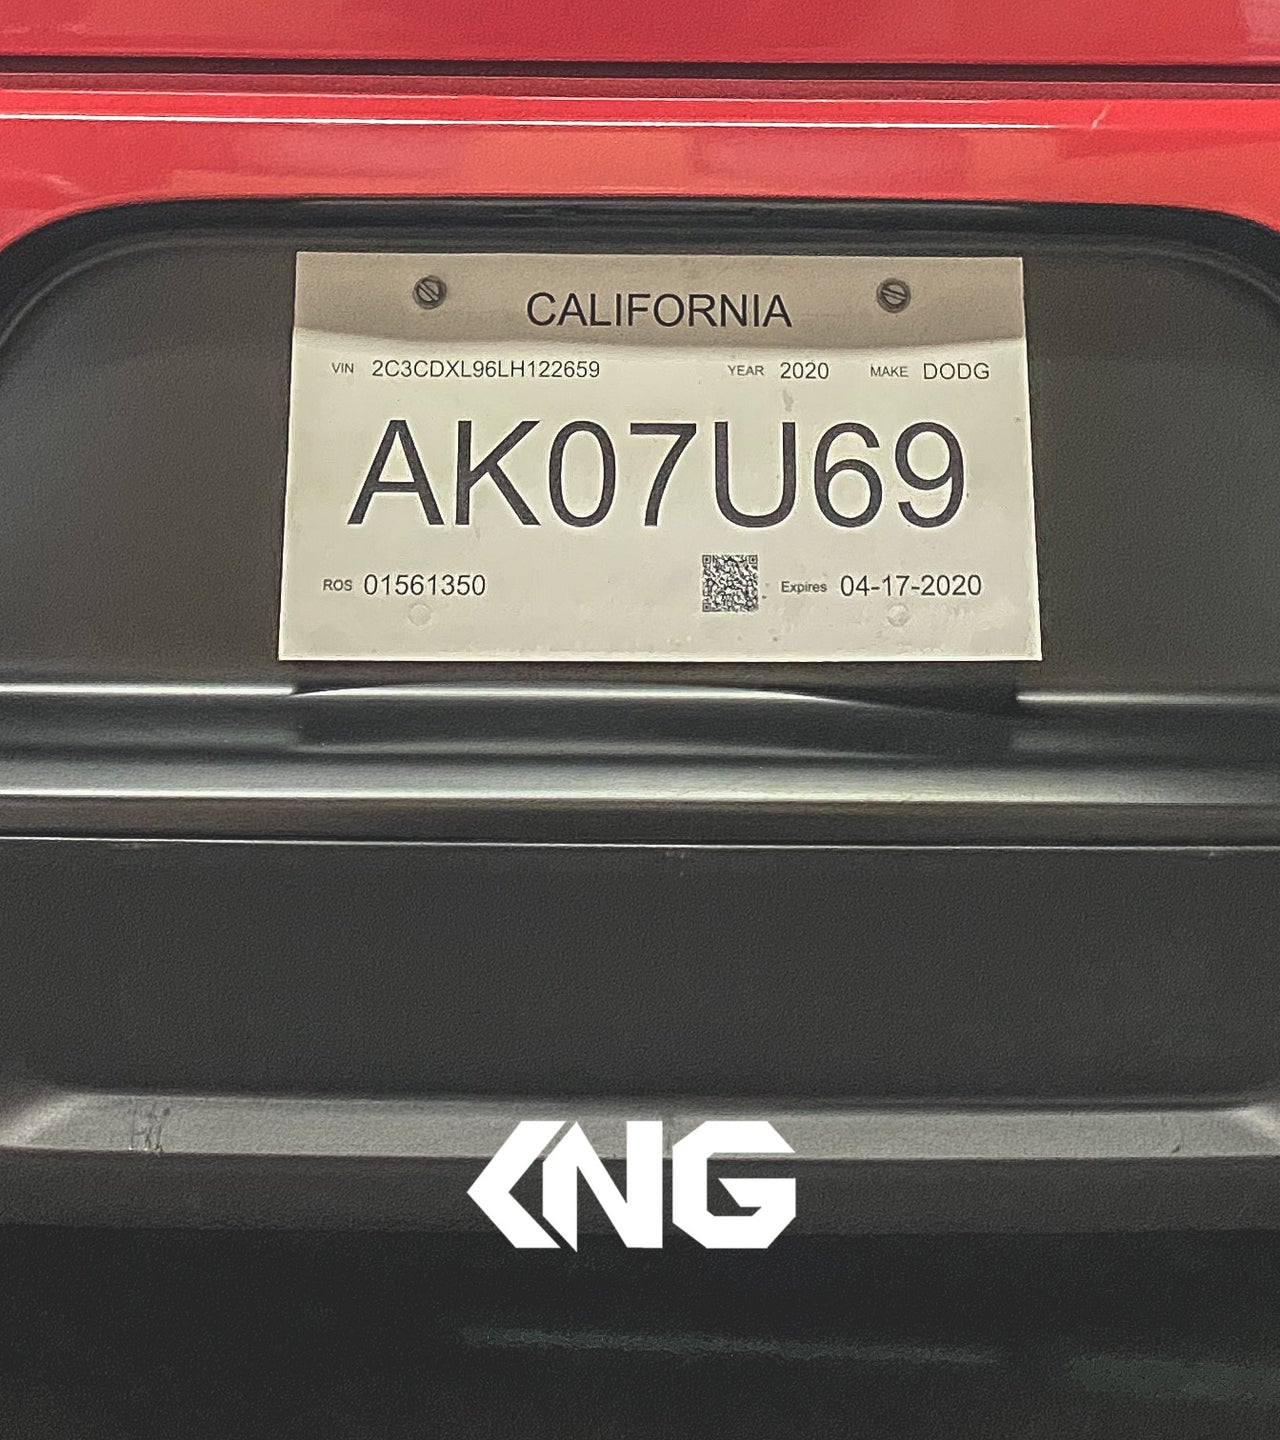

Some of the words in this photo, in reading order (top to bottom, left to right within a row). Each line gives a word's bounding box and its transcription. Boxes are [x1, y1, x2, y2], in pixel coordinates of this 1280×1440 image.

[527, 292, 793, 328] CALIFORNIA
[331, 362, 354, 374] VIN
[371, 359, 600, 378] 2C3CDXL96LH122659
[727, 364, 765, 376] YEAR
[780, 362, 829, 380] 2020
[870, 366, 908, 378] MAKE
[923, 362, 990, 380] DODG
[347, 419, 965, 528] AK07U69
[322, 578, 353, 592] ROS
[364, 574, 486, 596] 01561350
[781, 580, 828, 595] Expires
[840, 574, 982, 597] 04-17-2020
